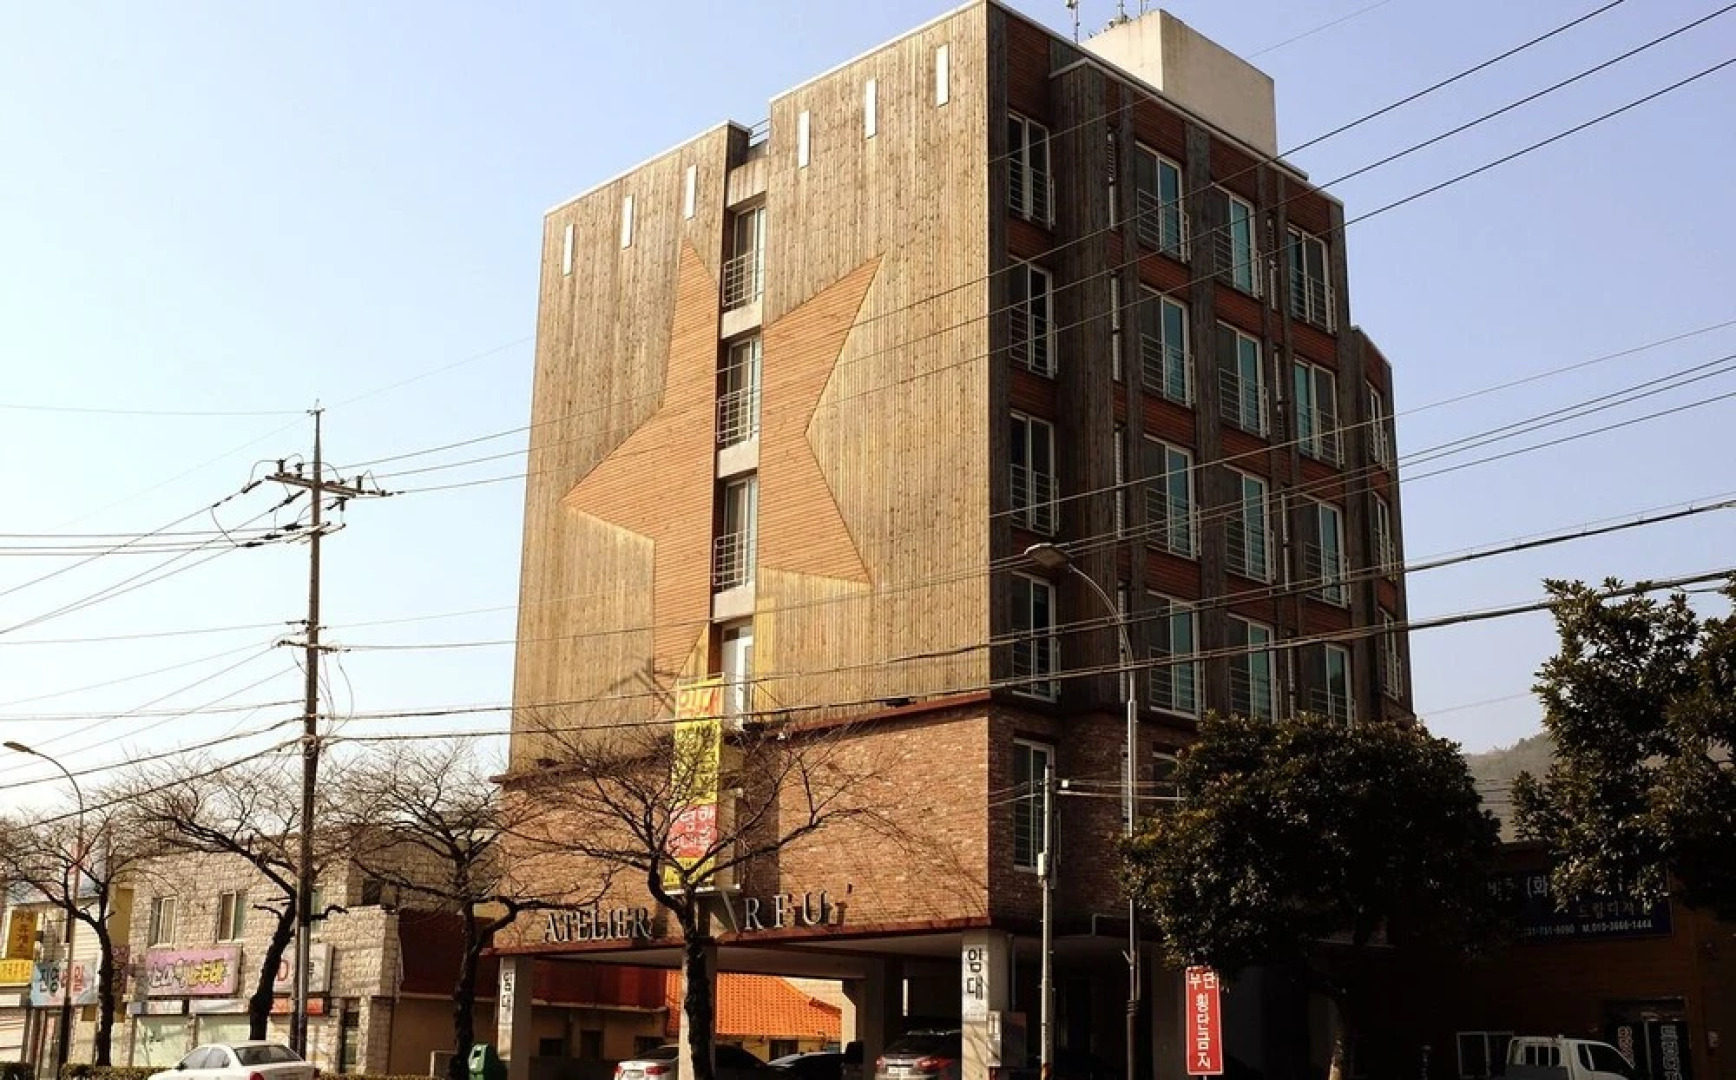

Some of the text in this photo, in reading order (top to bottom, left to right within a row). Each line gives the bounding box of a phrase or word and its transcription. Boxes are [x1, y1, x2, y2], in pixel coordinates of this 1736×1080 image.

[543, 907, 651, 943] ATELIER
[966, 947, 984, 1001] 임대
[1196, 992, 1211, 1070] 횡단금지
